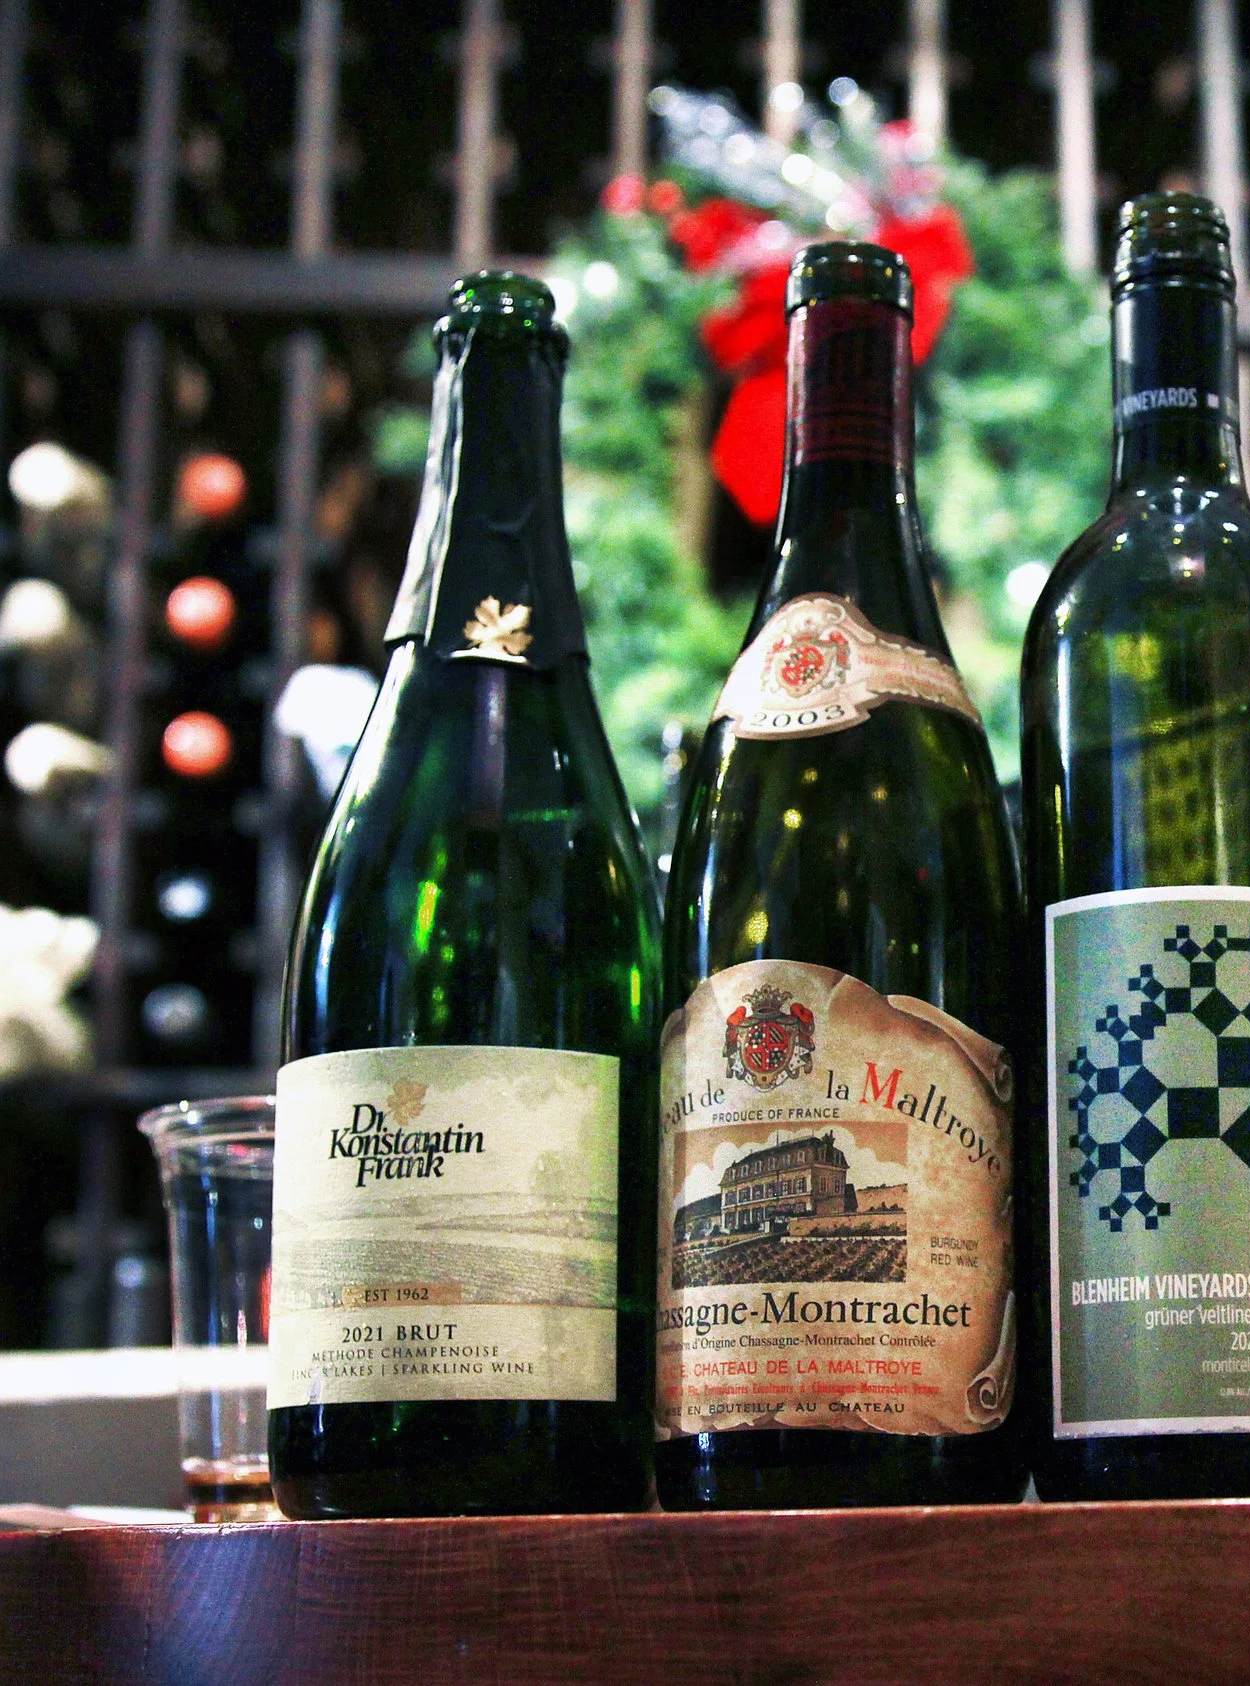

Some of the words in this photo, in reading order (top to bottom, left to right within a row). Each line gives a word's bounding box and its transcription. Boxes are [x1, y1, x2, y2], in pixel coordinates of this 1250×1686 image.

[350, 1103, 388, 1134] Dr.
[700, 1079, 725, 1108] de
[826, 1070, 850, 1100] la
[858, 1061, 1001, 1178] Maltroye
[712, 1110, 762, 1124] PRODUCE
[768, 1109, 783, 1120] OF
[788, 1107, 840, 1119] FRANCE
[328, 1122, 486, 1159] Konstantin
[355, 1143, 444, 1187] Frank
[930, 1236, 979, 1251] BURGUNDY
[930, 1253, 951, 1266] RED
[364, 1288, 389, 1302] EST
[396, 1287, 429, 1301] 1962
[1072, 1275, 1151, 1306] BLENHEIM
[1145, 1306, 1194, 1329] grüner
[342, 1326, 383, 1343] 2021
[397, 1324, 457, 1341] BRUT
[739, 1333, 875, 1350] Chassagne-Montrachet
[381, 1346, 499, 1359] CHAMPENOISE
[334, 1364, 373, 1377] LAKES
[392, 1361, 483, 1375] SPARKLING
[492, 1362, 534, 1374] WINE
[694, 1360, 758, 1376] CHATEAU
[767, 1360, 788, 1374] DE
[797, 1360, 818, 1374] LA
[829, 1360, 922, 1375] MALTROYE
[687, 1405, 701, 1416] EN
[709, 1402, 785, 1414] BOUTEILLE
[795, 1402, 816, 1412] AU
[829, 1402, 905, 1413] CHATEAU
